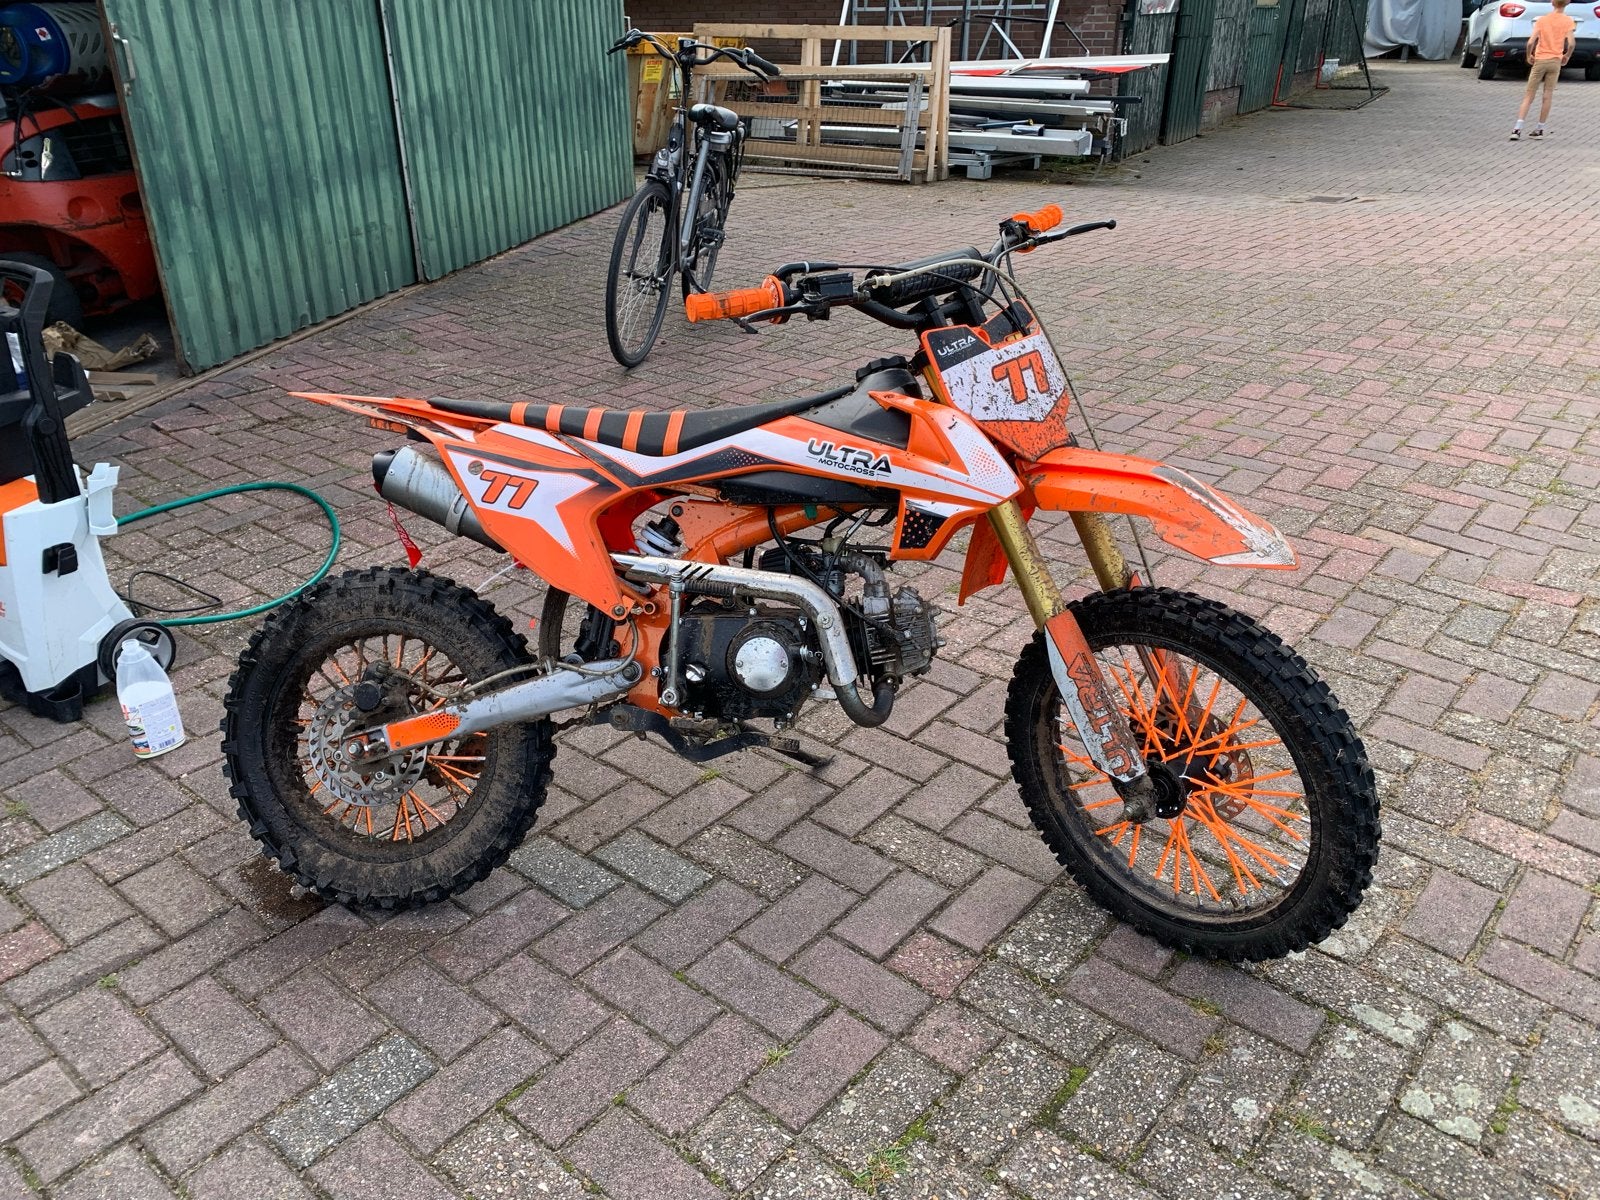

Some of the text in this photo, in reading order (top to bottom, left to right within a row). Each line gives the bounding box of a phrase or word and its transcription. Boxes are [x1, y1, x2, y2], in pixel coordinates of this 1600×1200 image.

[937, 335, 976, 356] ULTRA
[991, 349, 1051, 405] 77
[807, 439, 892, 474] ULTRA
[818, 458, 875, 476] MOTOCROSS
[480, 469, 539, 509] 77
[1067, 652, 1132, 777] ULTRA
